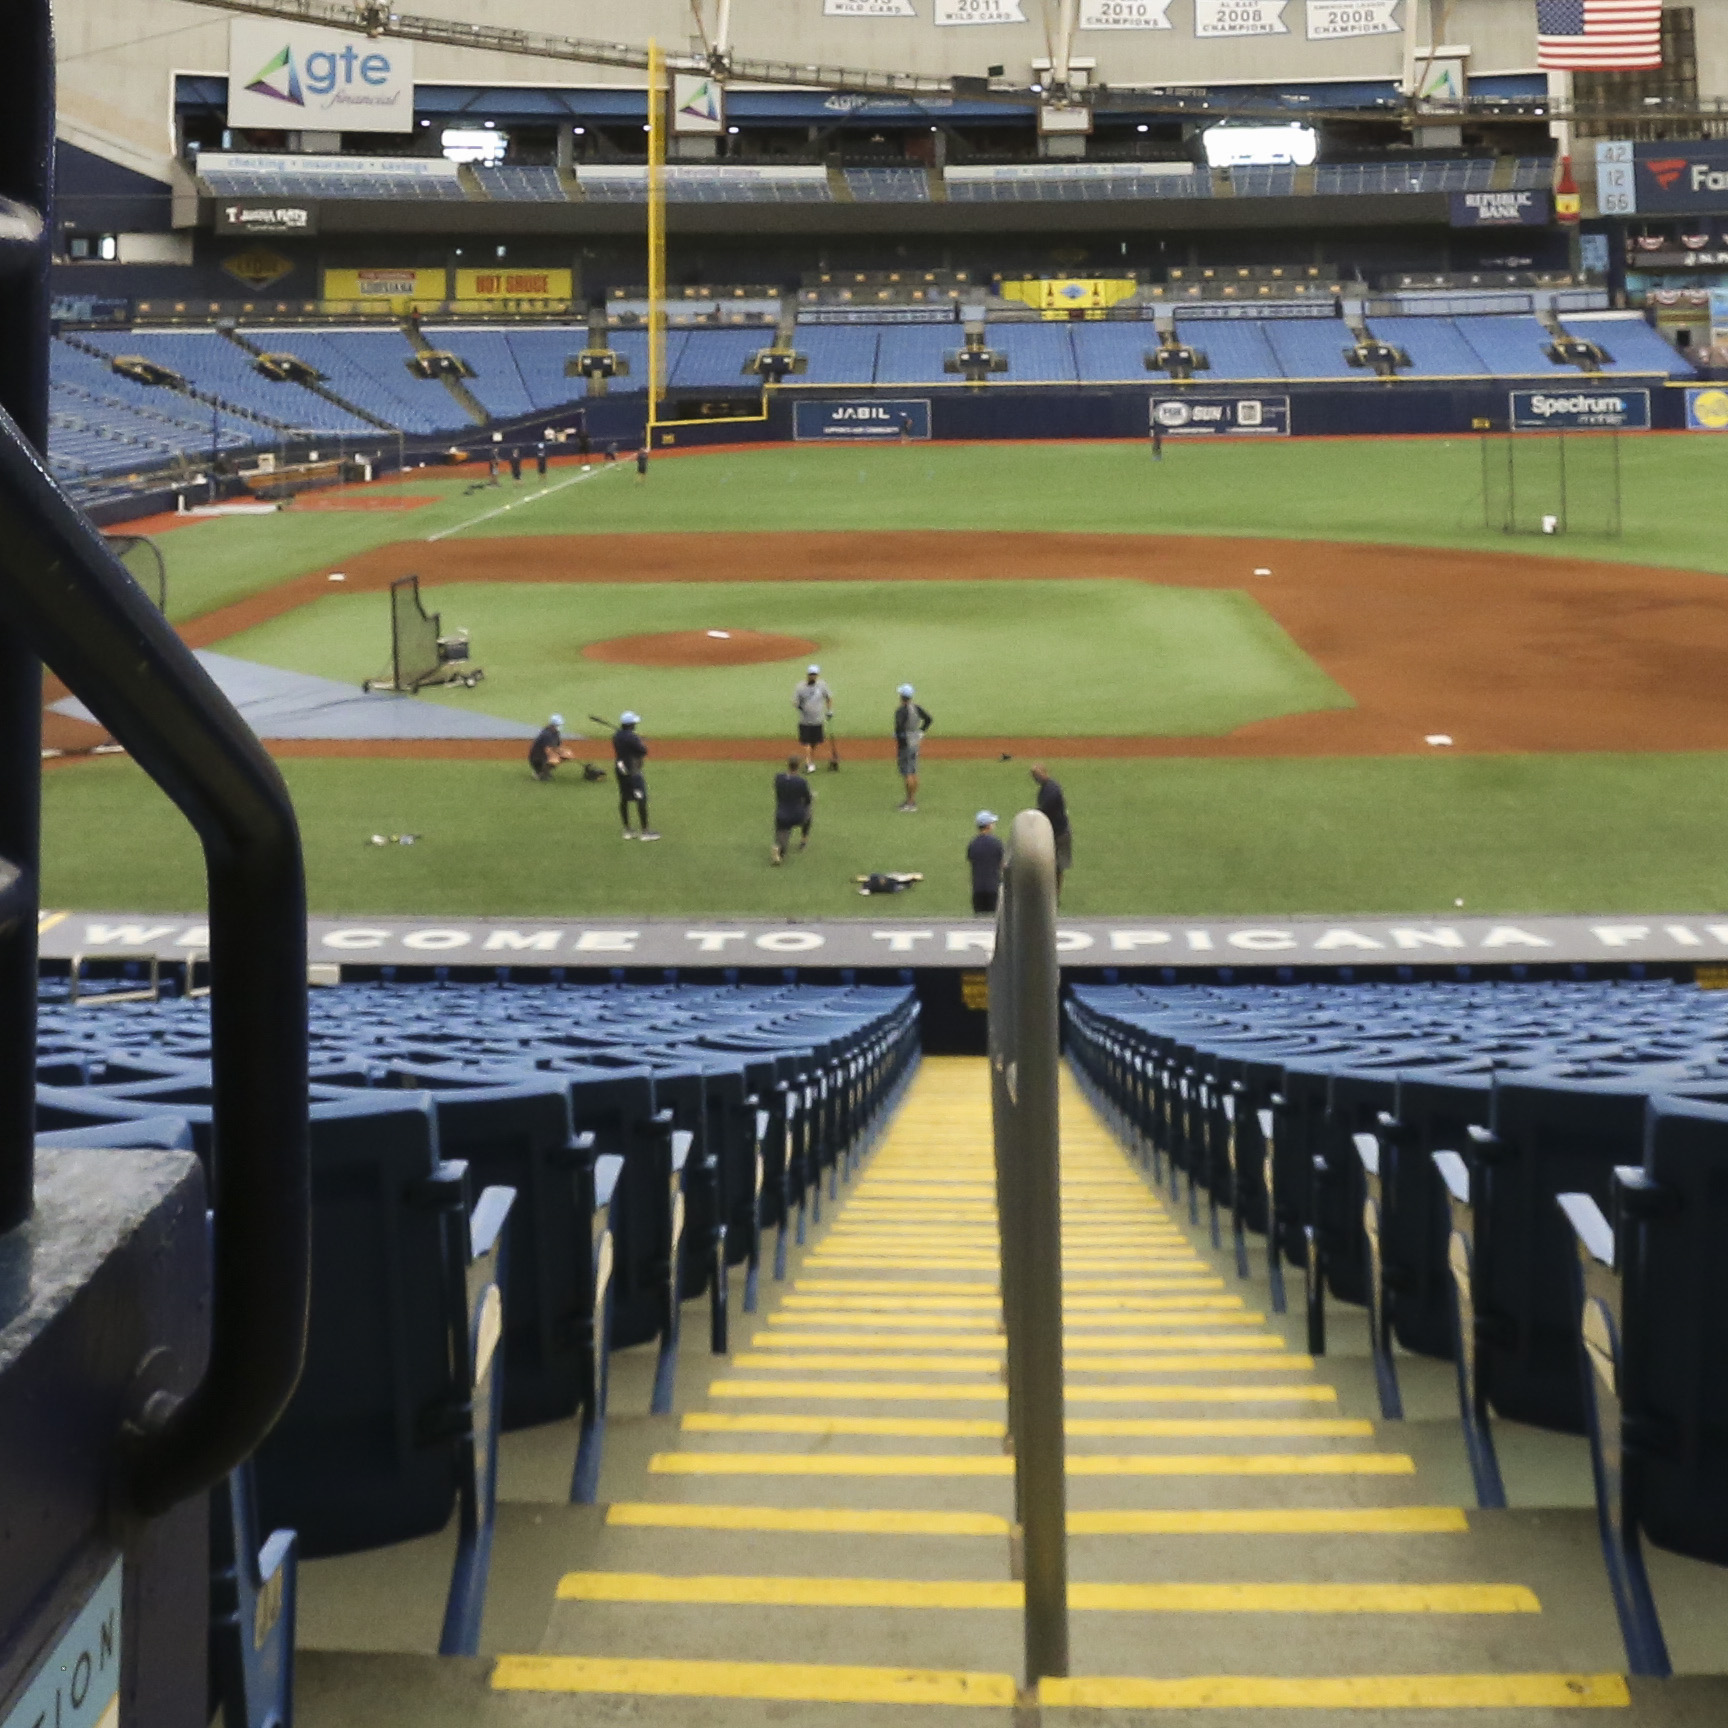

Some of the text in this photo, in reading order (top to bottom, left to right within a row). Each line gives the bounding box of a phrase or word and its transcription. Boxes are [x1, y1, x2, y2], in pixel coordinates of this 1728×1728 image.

[835, 3, 901, 14] WILD CARD
[957, 0, 1001, 12] 2011
[1100, 3, 1147, 17] 2010
[945, 12, 1012, 20] WILD CARD
[1086, 16, 1159, 27] CHAMPIONS
[1216, 9, 1262, 22] 2008
[1328, 10, 1375, 24] 2008
[1202, 23, 1273, 33] CHAMPIONS
[1314, 23, 1389, 35] CHAMPIONS
[305, 44, 391, 94] gte
[320, 88, 401, 109] financial
[1605, 147, 1627, 162] 42
[227, 157, 286, 172] checking
[1607, 169, 1624, 187] 12
[1464, 192, 1532, 208] REPUBLIC
[1479, 205, 1521, 219] BANK
[476, 275, 500, 293] HOT
[1531, 395, 1622, 417] Spectrum
[831, 407, 890, 420] JABIL
[685, 930, 826, 952] TO
